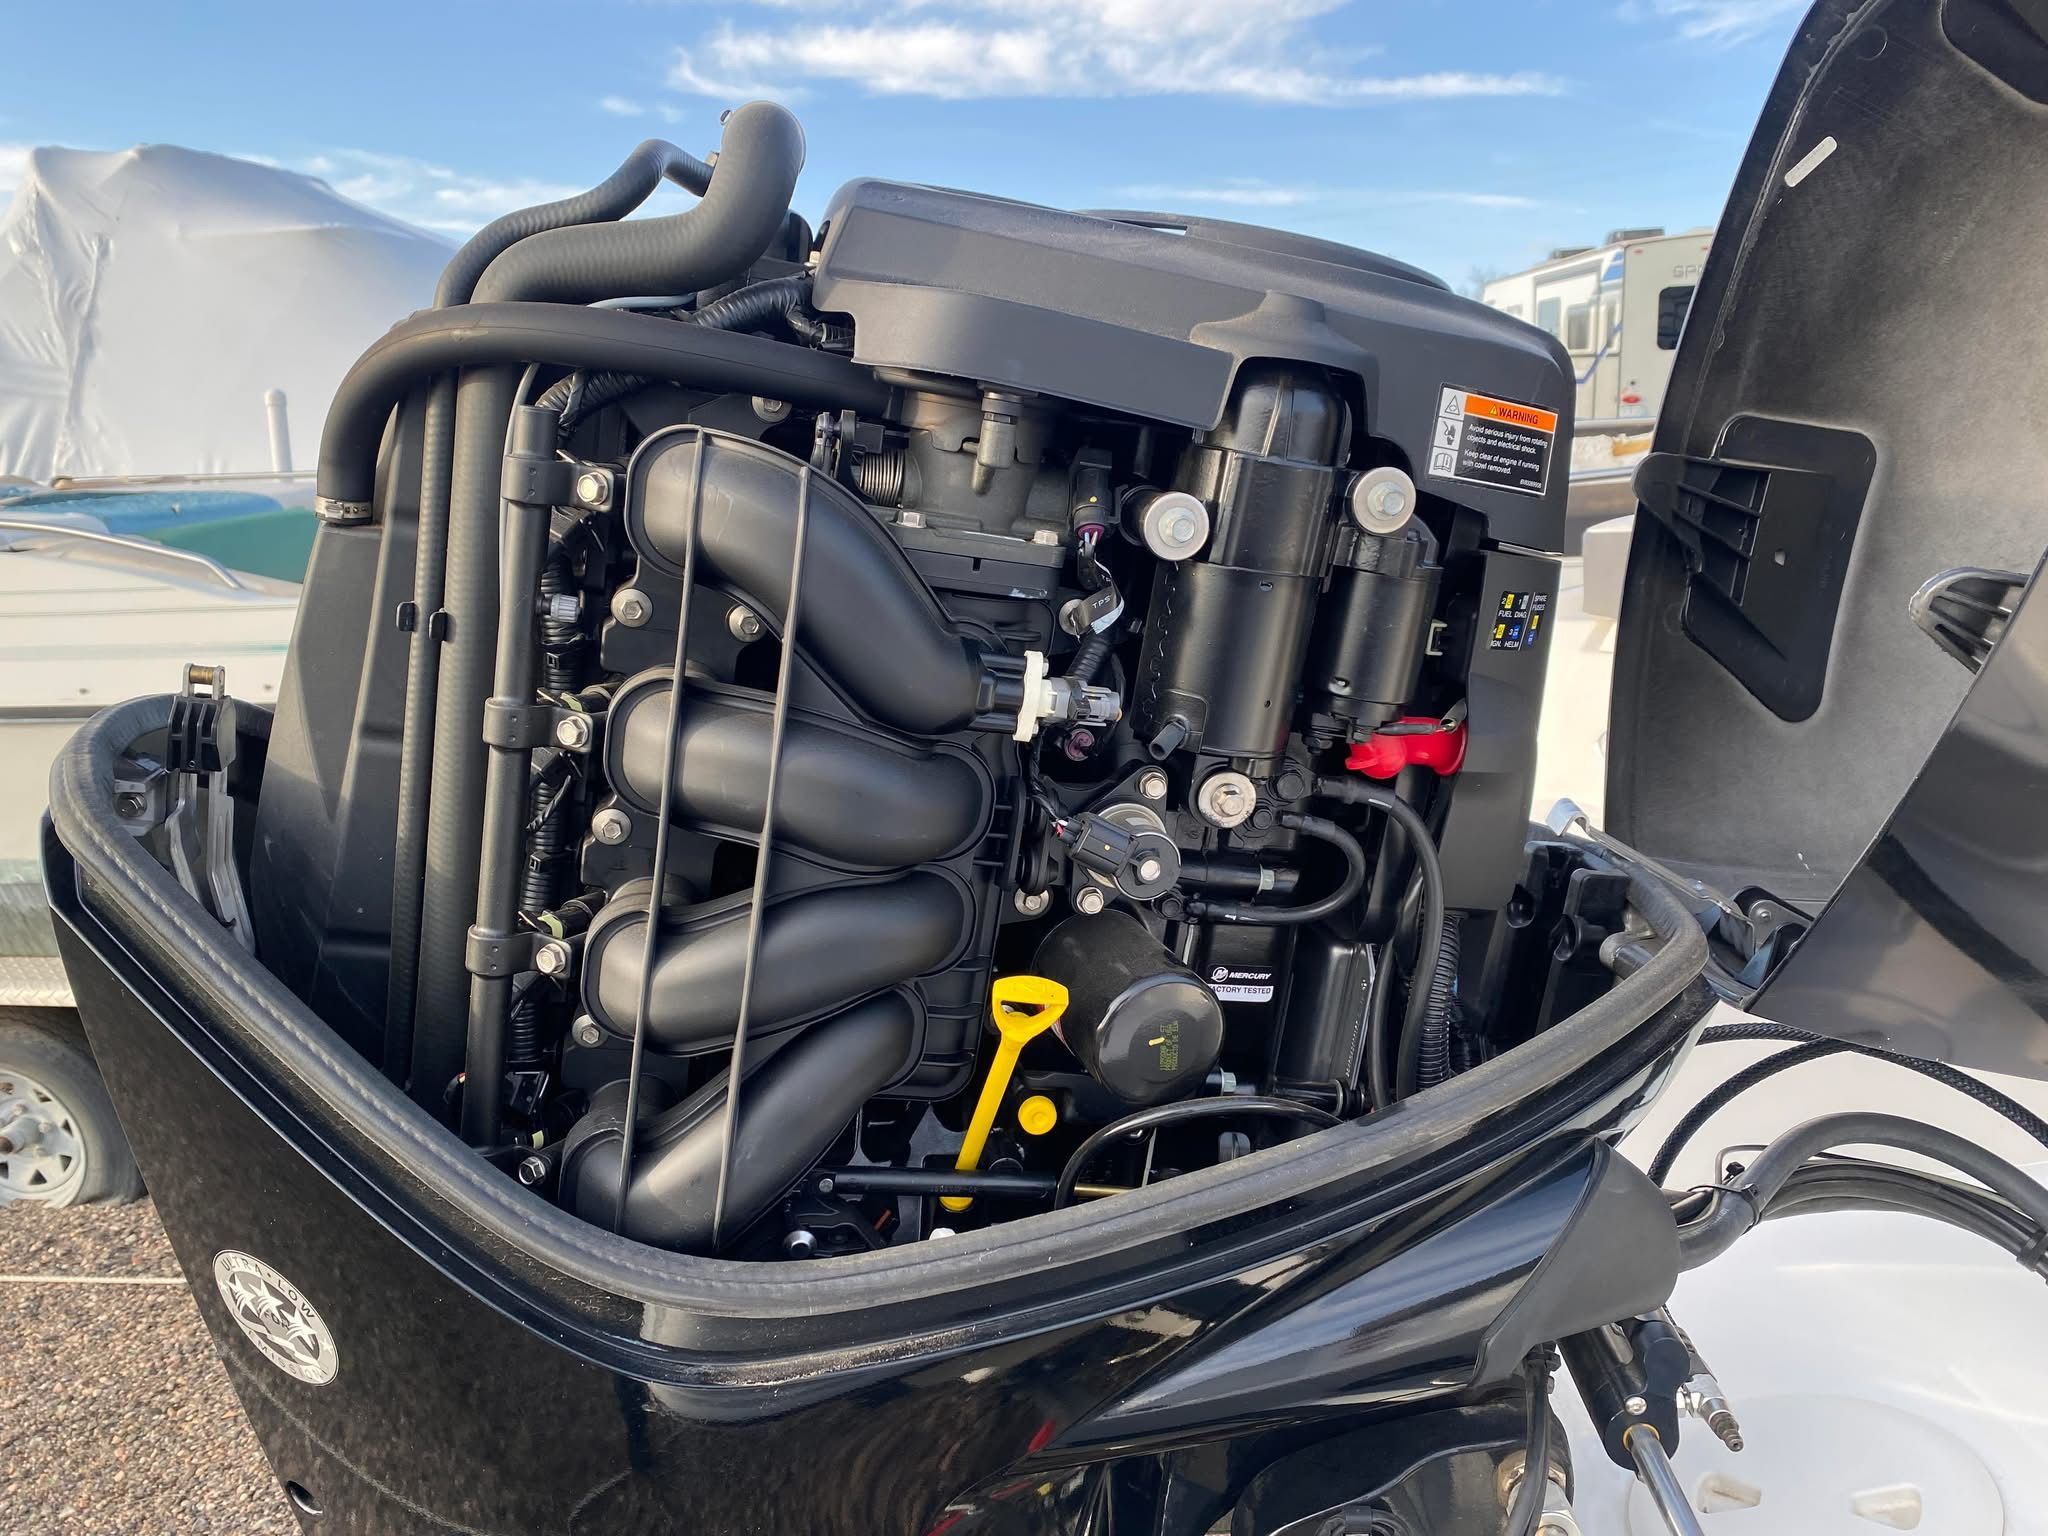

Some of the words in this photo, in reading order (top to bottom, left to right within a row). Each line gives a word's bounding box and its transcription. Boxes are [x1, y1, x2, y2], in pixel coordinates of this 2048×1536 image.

[1499, 407, 1538, 424] WARNING
[1467, 434, 1486, 444] objects
[1498, 440, 1521, 450] electrical
[1521, 445, 1537, 454] shock.
[1469, 424, 1485, 433] Avoid
[1485, 427, 1503, 438] serious
[1504, 432, 1519, 442] injury
[1520, 434, 1530, 443] from
[1531, 437, 1548, 449] rotating
[1464, 449, 1479, 458] Keep
[1479, 452, 1493, 460] clear
[1500, 457, 1517, 466] engine
[1522, 461, 1540, 472] running
[1487, 464, 1512, 475] removed.
[1092, 595, 1110, 608] TPS
[1502, 597, 1506, 605] 2
[1498, 610, 1512, 618] FUEL
[1211, 985, 1241, 993] ACTORY
[221, 1256, 263, 1276] ULTRA
[277, 1279, 315, 1318] LOW
